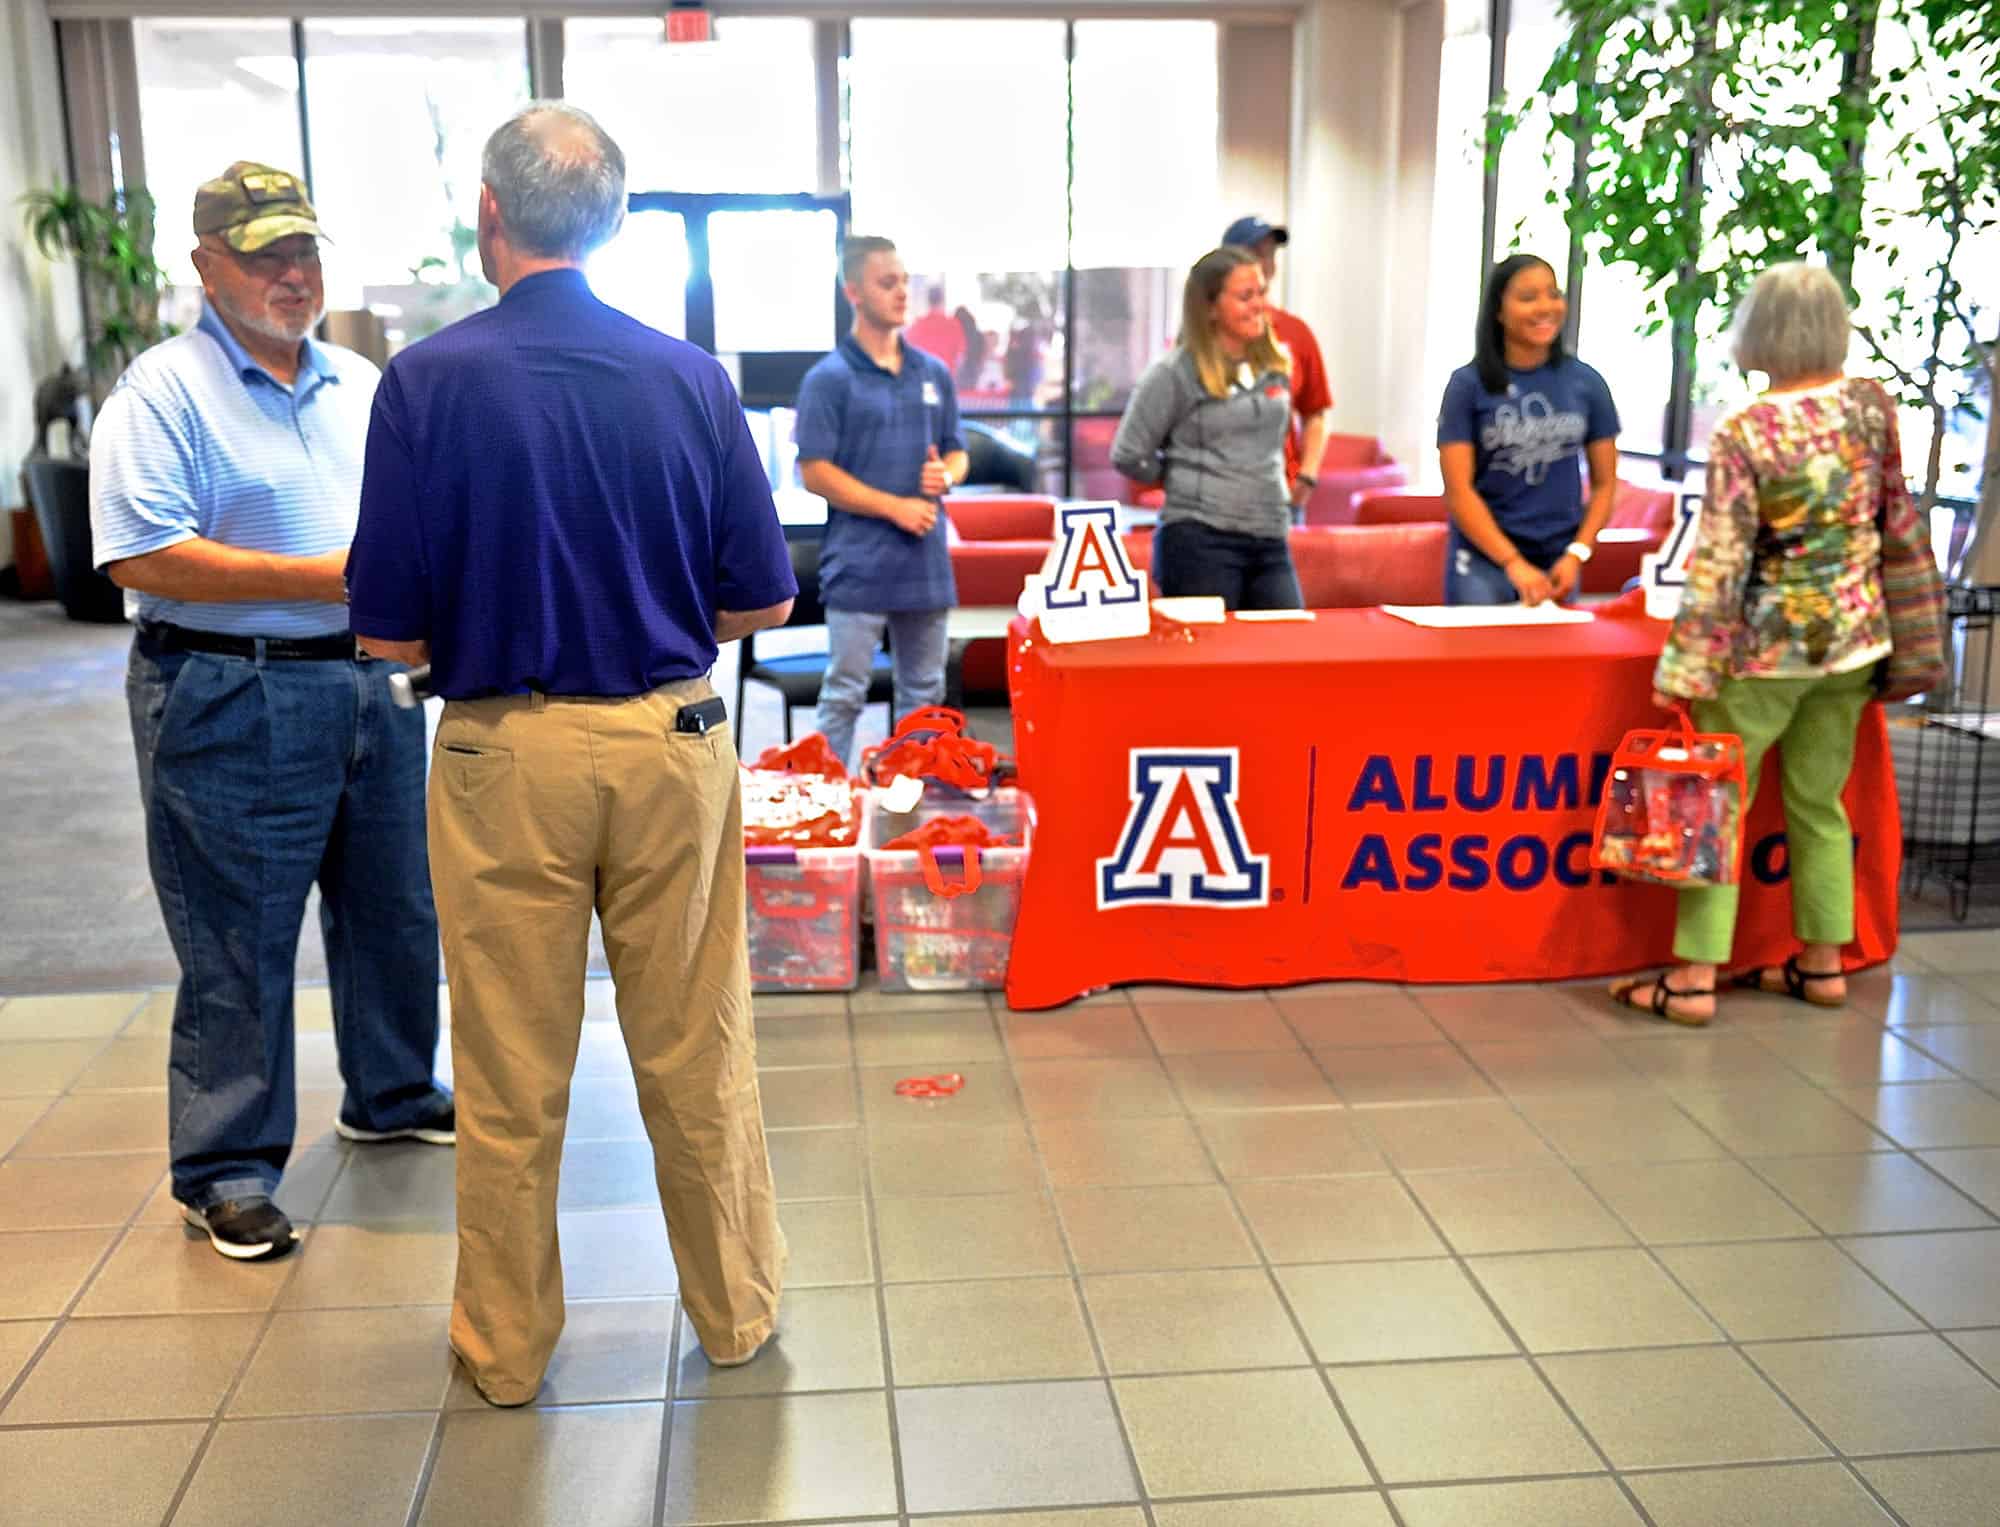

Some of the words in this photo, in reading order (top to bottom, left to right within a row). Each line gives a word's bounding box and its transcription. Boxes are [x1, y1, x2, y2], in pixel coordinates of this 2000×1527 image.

[1045, 506, 1141, 610] A
[1346, 754, 1612, 812] ALUM
[1097, 747, 1269, 910] A
[1340, 832, 1861, 892] ASSOCO
